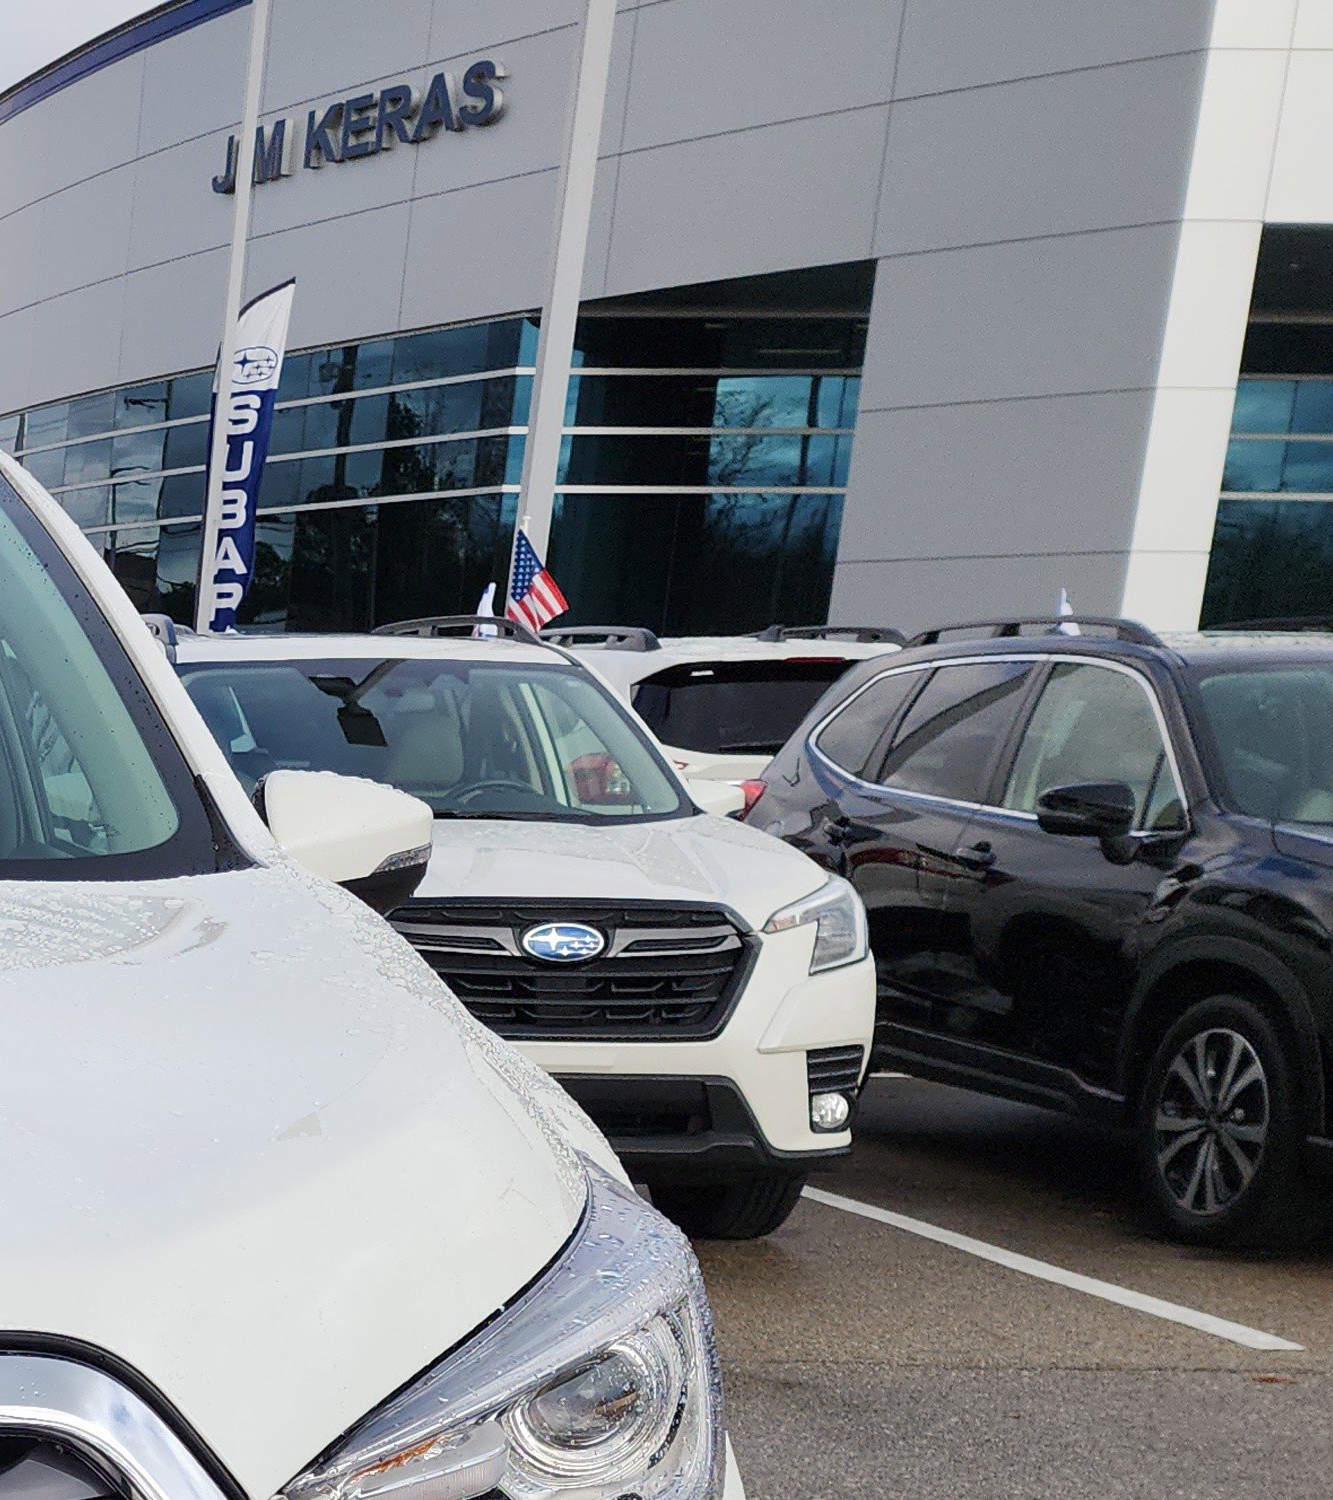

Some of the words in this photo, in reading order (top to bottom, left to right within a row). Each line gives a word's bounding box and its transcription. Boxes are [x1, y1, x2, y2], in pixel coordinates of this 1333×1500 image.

[211, 118, 293, 195] JM
[303, 60, 509, 169] KERAS
[209, 392, 262, 633] SUBAR
